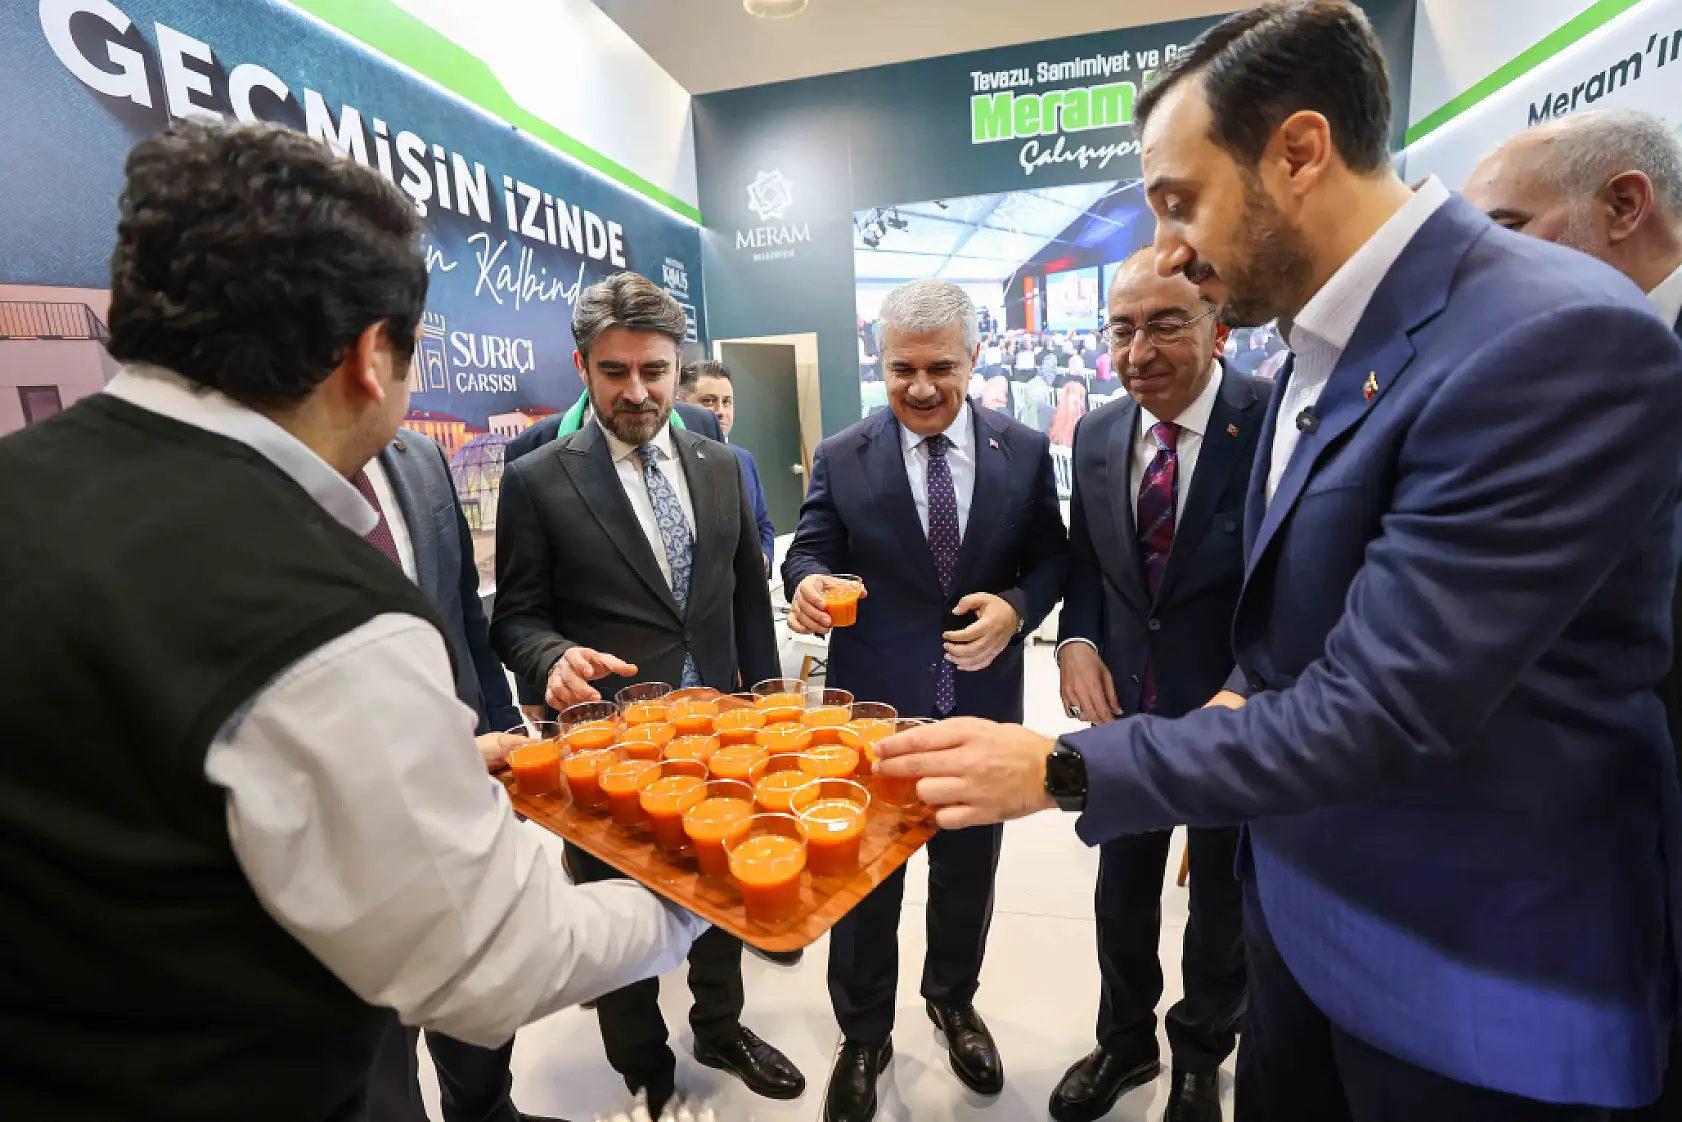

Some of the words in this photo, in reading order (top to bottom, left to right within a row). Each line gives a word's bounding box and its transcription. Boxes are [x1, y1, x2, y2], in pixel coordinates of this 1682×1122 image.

[970, 67, 1034, 91] Tevazu,
[1036, 50, 1131, 83] Samimiyet
[1136, 49, 1159, 69] ve
[971, 82, 1136, 144] Meram
[503, 175, 626, 268] İZİNDE
[735, 221, 812, 250] MERAM
